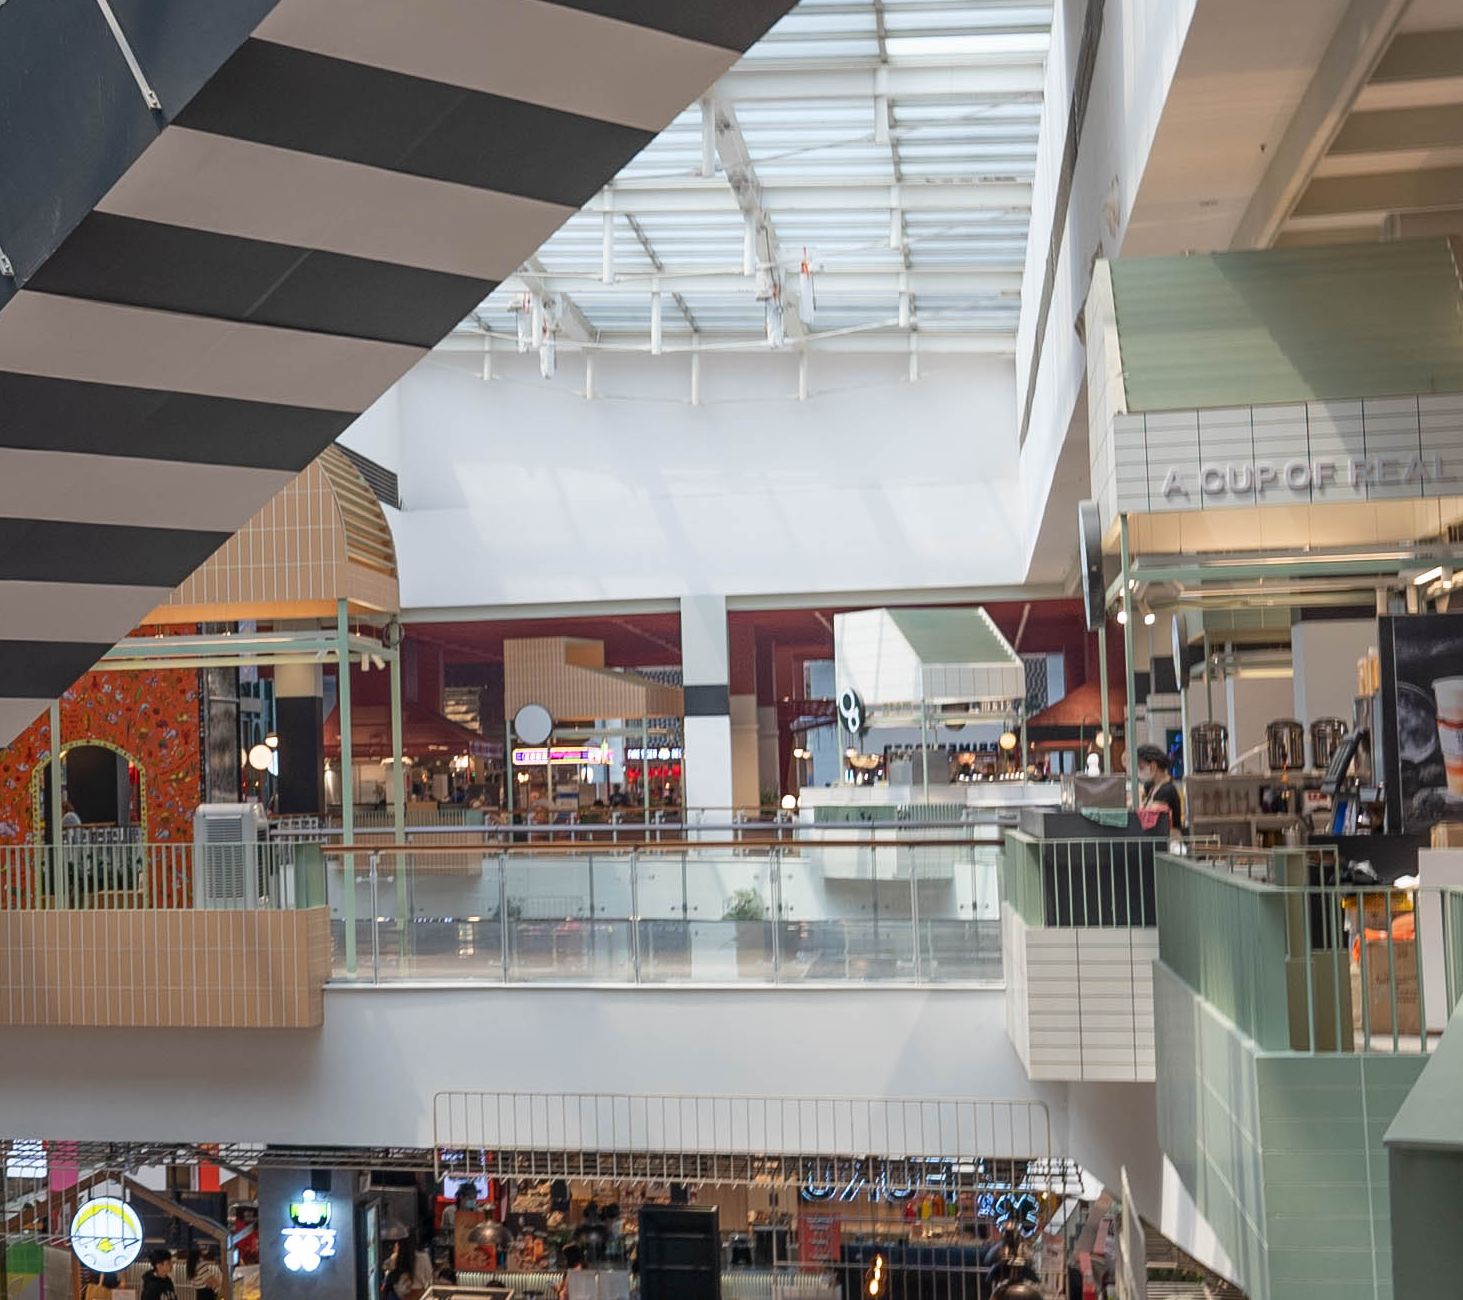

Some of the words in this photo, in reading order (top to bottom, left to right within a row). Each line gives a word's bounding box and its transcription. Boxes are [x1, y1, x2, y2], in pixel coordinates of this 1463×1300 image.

[1162, 466, 1191, 499] A
[1201, 461, 1276, 495] CUP
[1284, 457, 1337, 491] OF
[1348, 452, 1457, 487] REAL
